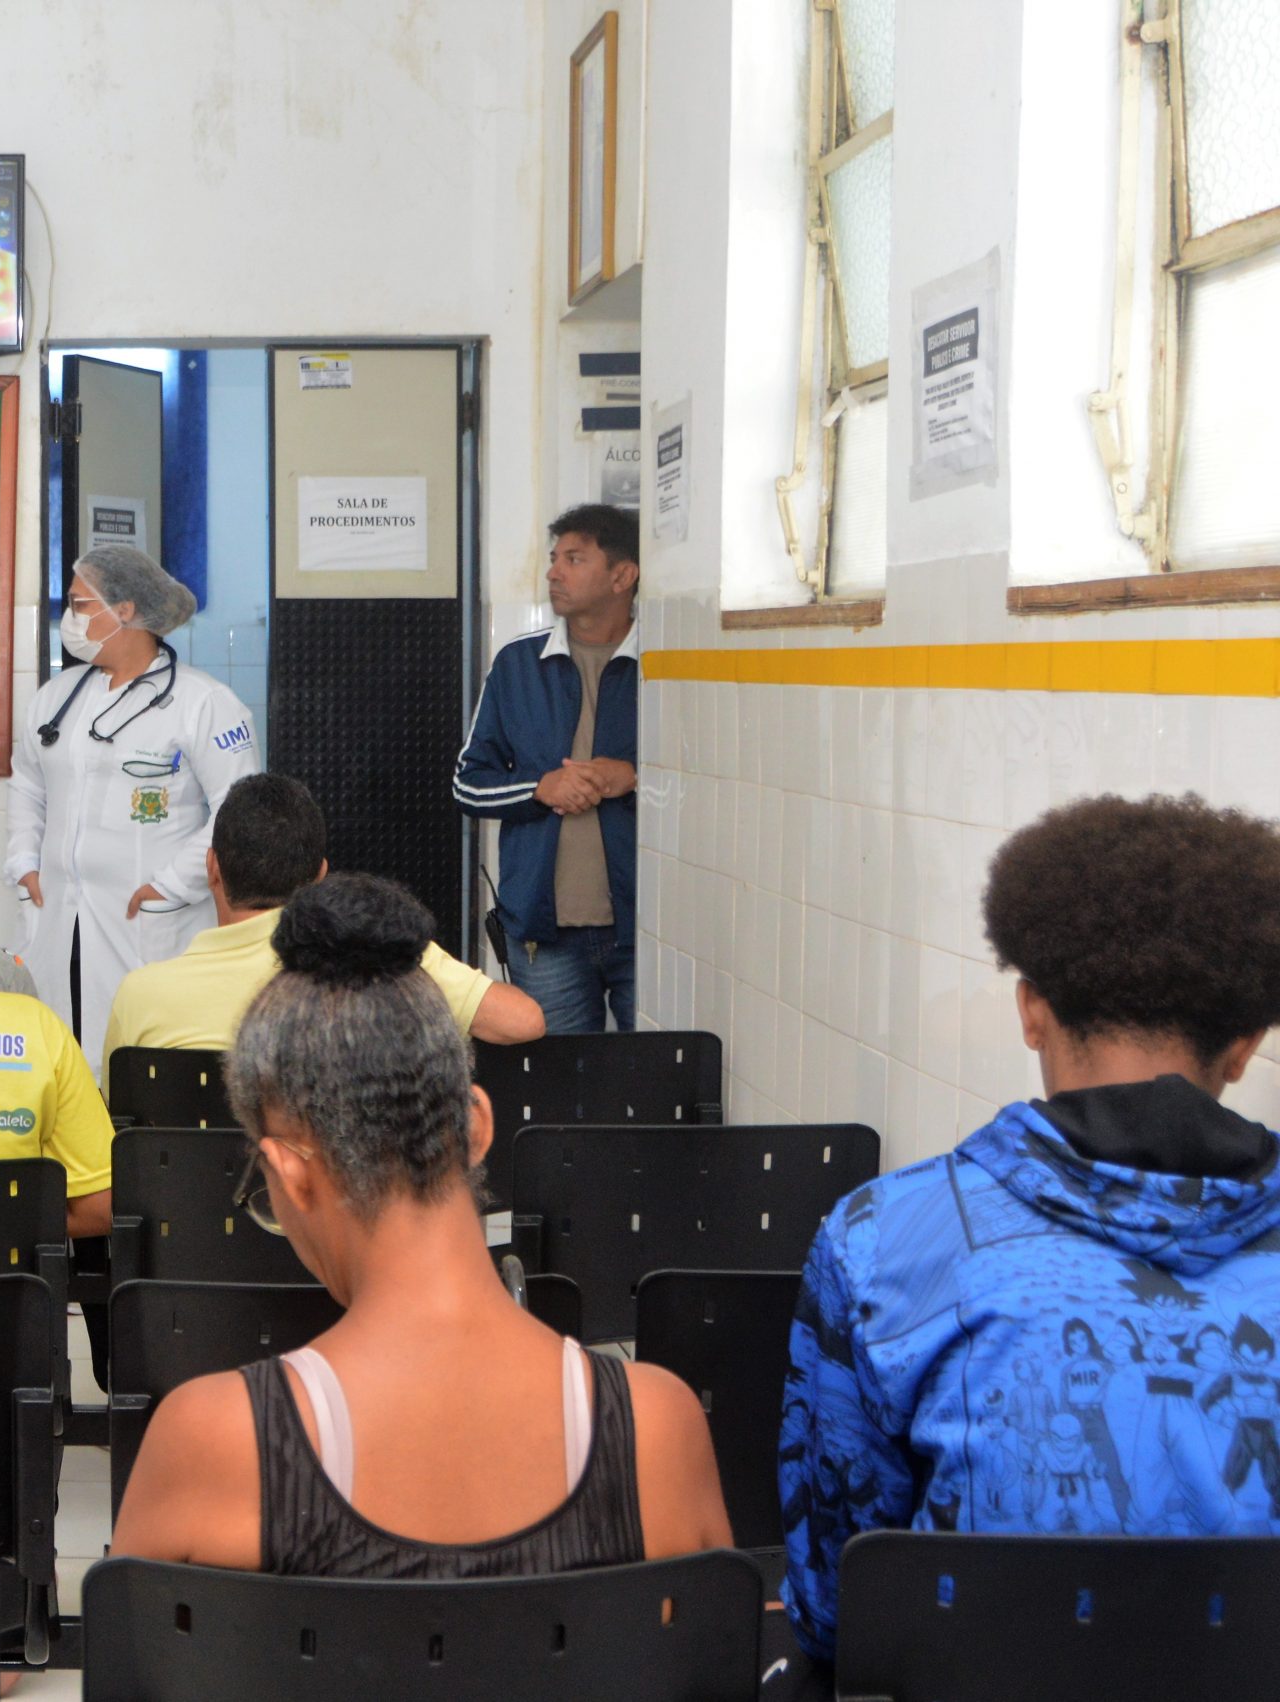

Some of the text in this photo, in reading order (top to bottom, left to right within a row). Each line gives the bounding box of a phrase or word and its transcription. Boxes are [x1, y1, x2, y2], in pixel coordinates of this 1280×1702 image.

[337, 498, 388, 509] SALA DE
[309, 516, 416, 527] PROCEDIMENTOS
[1071, 1370, 1099, 1387] MIR
